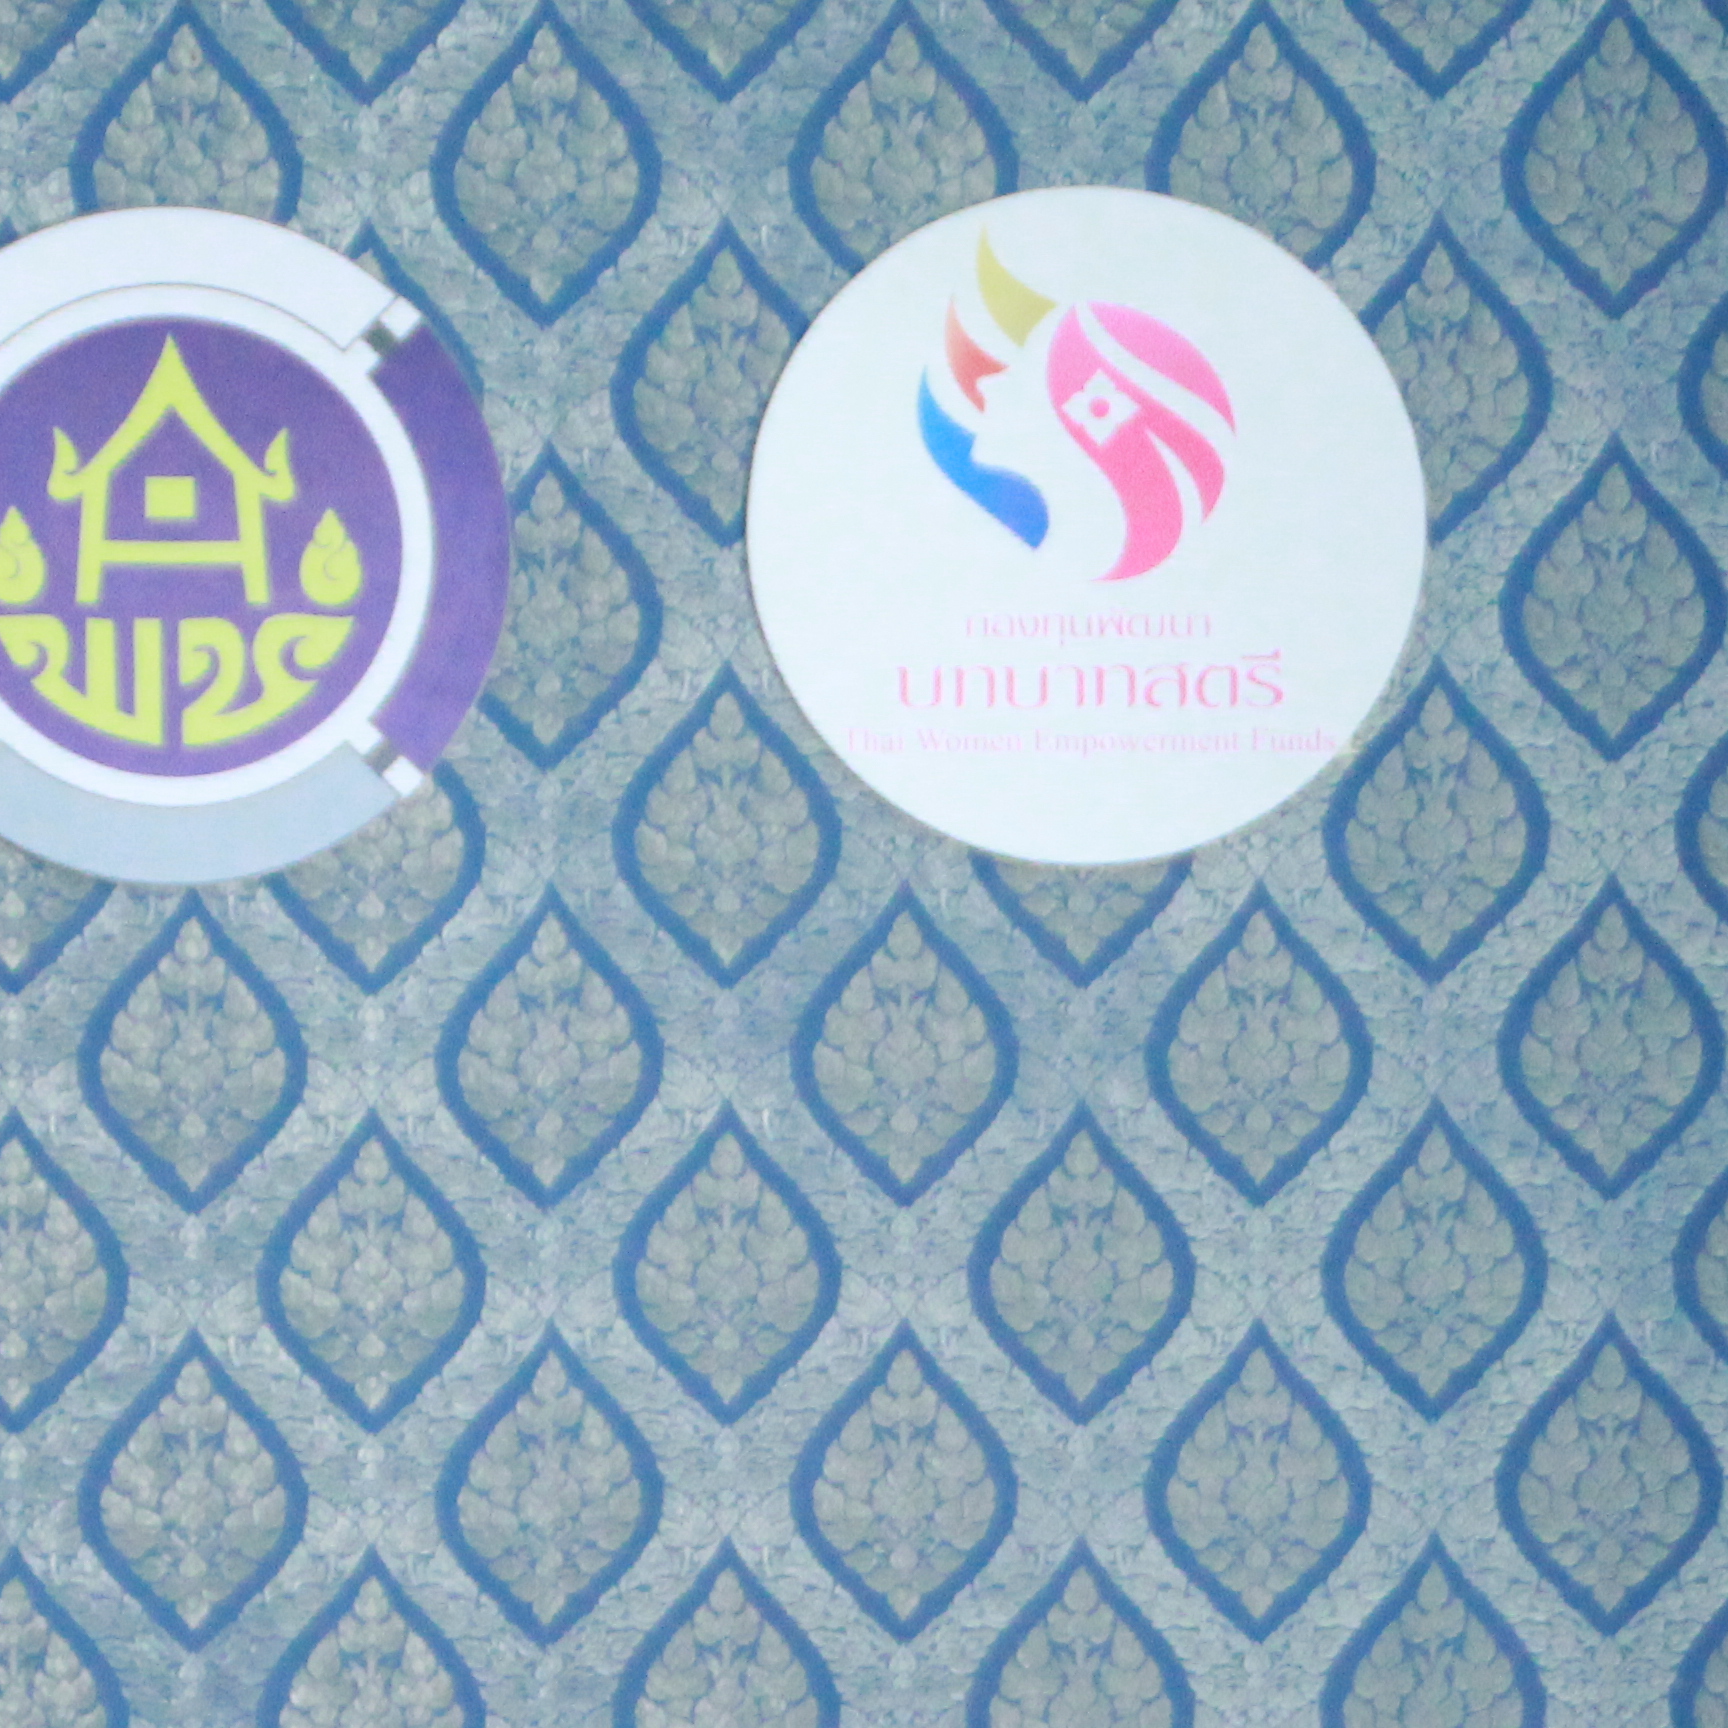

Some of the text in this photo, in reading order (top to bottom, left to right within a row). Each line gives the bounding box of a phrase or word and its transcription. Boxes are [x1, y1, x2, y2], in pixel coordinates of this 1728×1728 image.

[964, 605, 1213, 645] กองทุนพัฒนา
[896, 648, 1285, 708] บทบาทสตรี
[843, 726, 1337, 758] Thai Women Empowerment Funds
